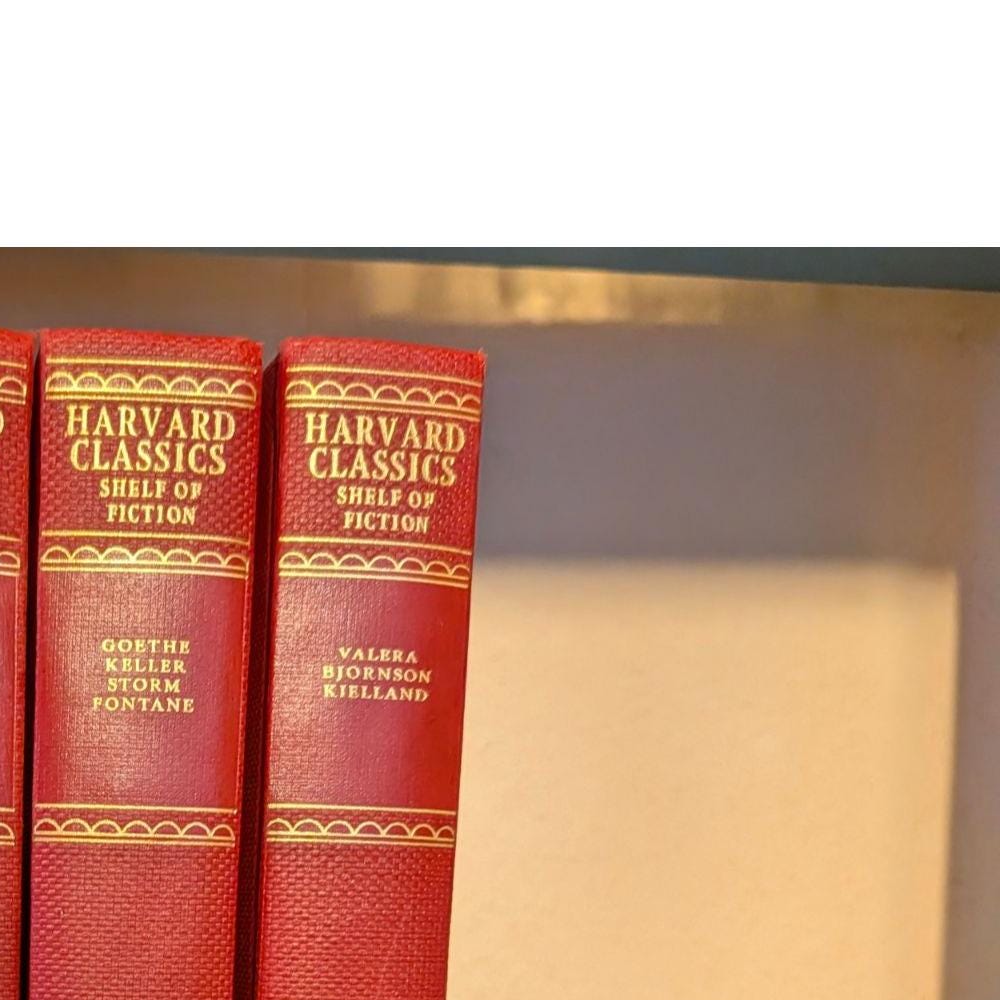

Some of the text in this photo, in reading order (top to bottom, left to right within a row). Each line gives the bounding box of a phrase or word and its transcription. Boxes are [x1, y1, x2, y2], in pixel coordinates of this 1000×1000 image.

[66, 403, 236, 442] HARVARD
[304, 411, 467, 454] HARVARD
[70, 439, 227, 475] CLASSICS
[308, 447, 458, 487] CLASSICS
[100, 477, 202, 501] SHELF OF
[337, 486, 435, 509] SHELF OF
[106, 504, 197, 525] FICTION
[343, 510, 430, 533] FICTION
[101, 638, 190, 654] GOETHE
[338, 646, 418, 664] VALERA
[105, 657, 187, 674] KELLER
[322, 664, 432, 684] BJORNSON
[107, 677, 181, 693] STORM
[322, 684, 429, 702] KIELLAND
[93, 696, 195, 713] FONTANE
